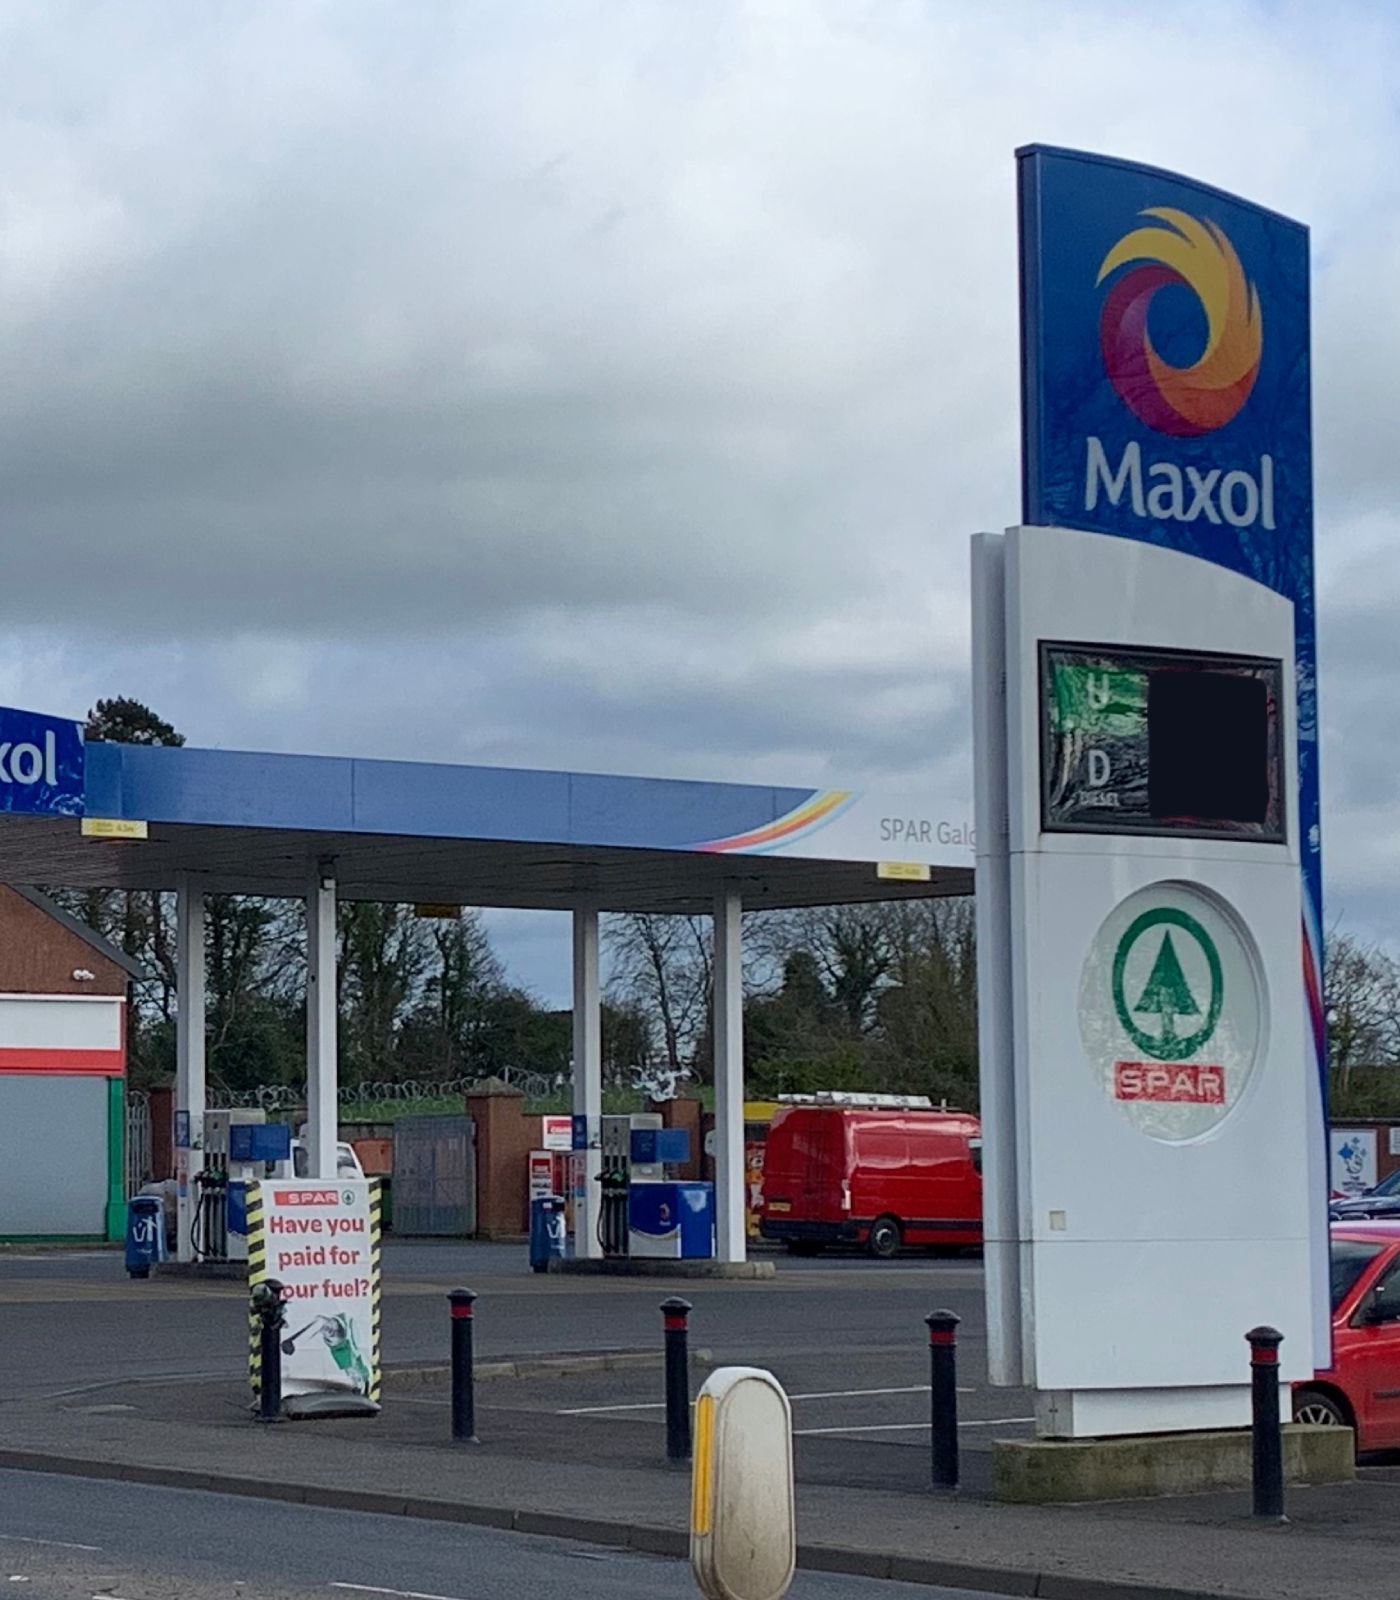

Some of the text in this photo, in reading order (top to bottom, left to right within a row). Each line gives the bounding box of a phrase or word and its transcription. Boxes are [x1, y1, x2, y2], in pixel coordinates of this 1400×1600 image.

[1085, 436, 1276, 530] Maxol
[1088, 750, 1111, 787] D
[880, 818, 932, 842] SPAR
[1120, 1069, 1221, 1096] SPAR
[287, 1192, 338, 1204] SPAR
[270, 1216, 364, 1237] Have you
[278, 1245, 360, 1271] paid for
[282, 1279, 370, 1299] our fuel?
